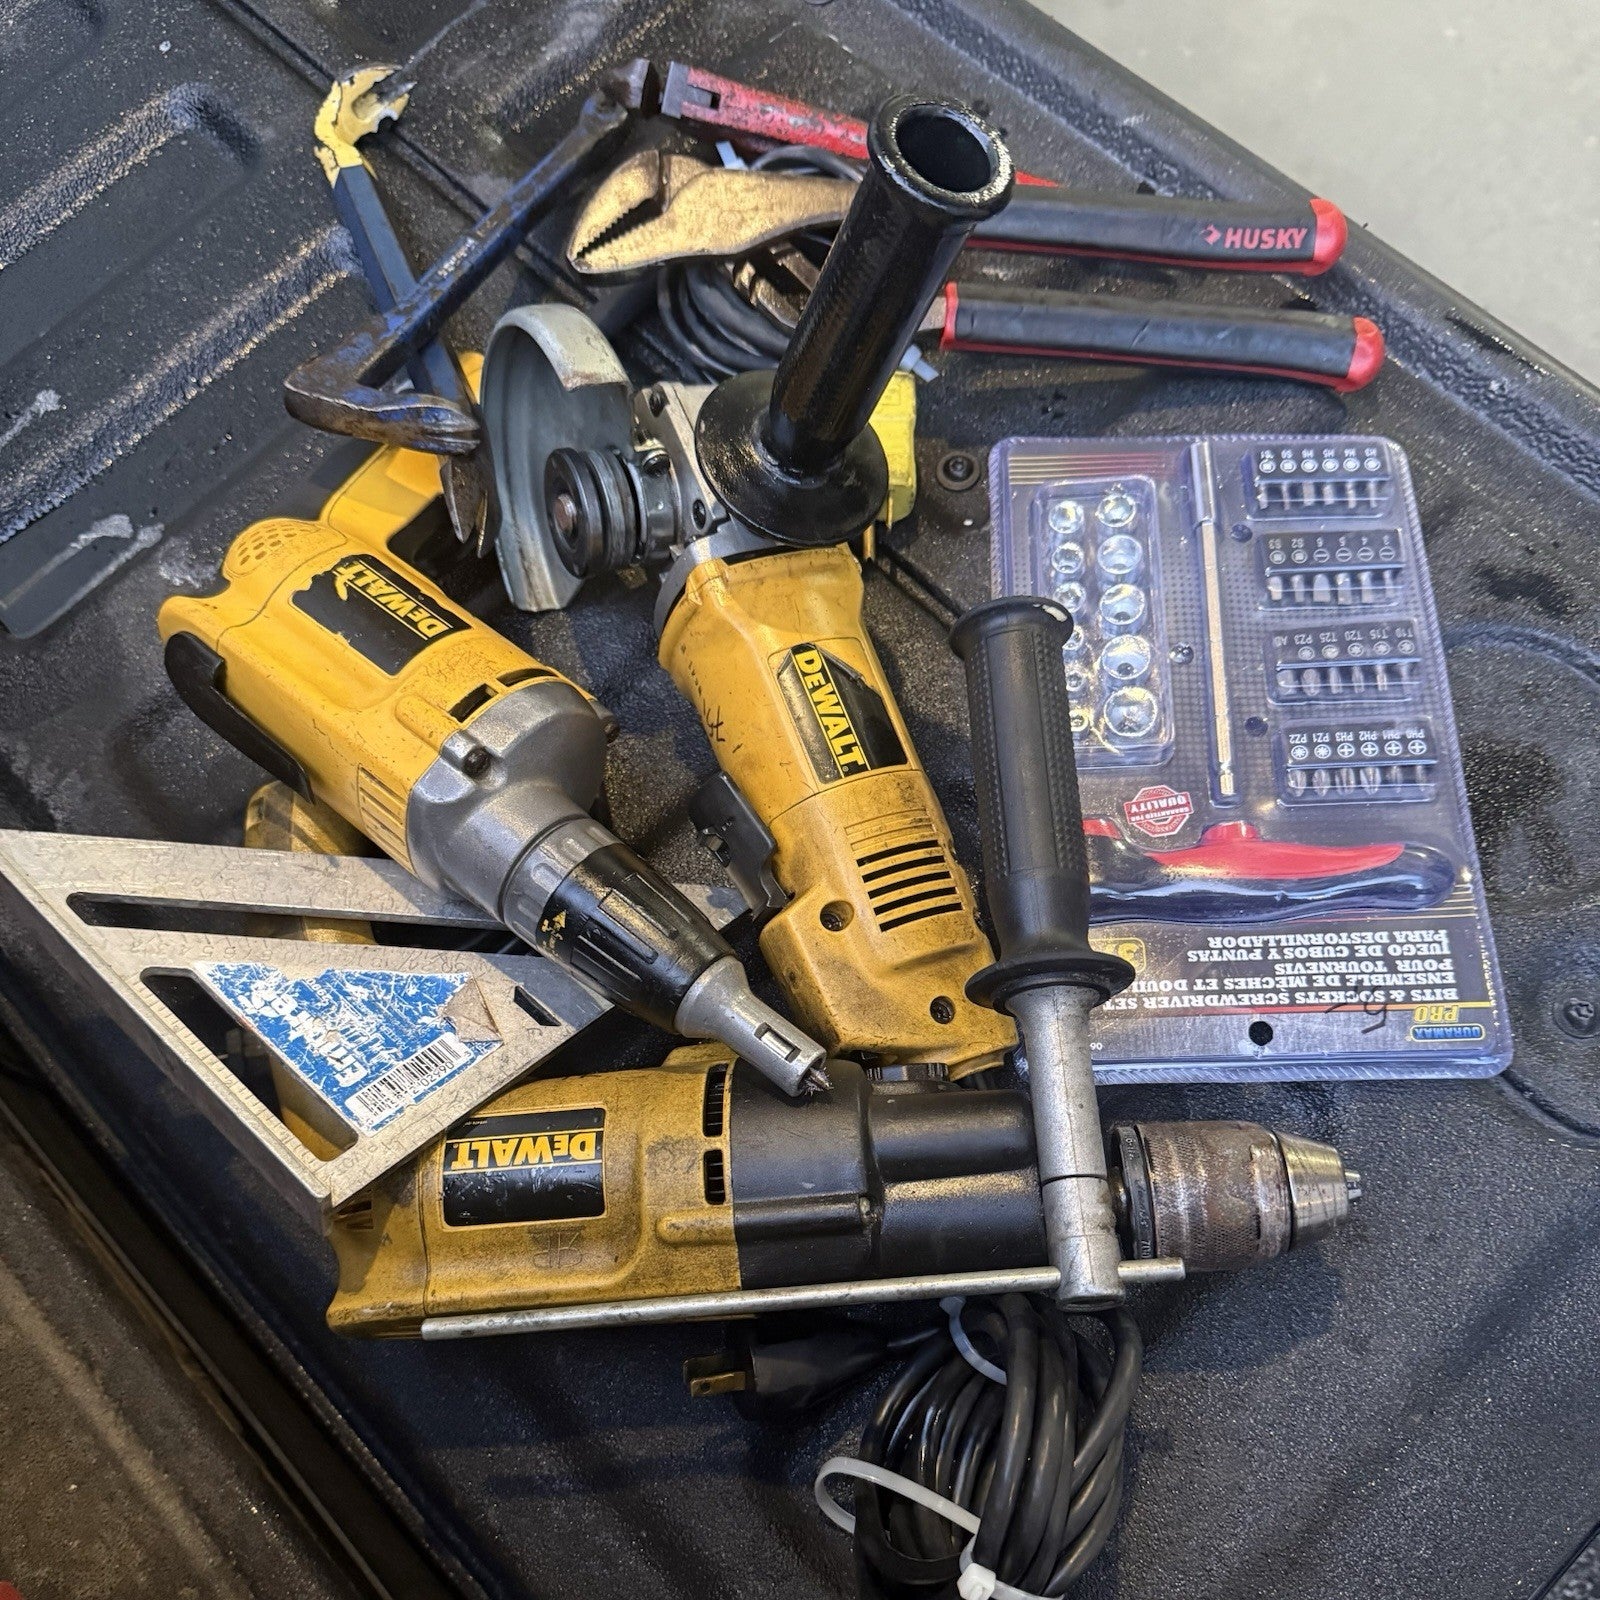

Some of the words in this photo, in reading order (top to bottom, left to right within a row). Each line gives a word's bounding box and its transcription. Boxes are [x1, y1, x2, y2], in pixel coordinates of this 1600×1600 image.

[1223, 227, 1308, 249] HUSKY
[1294, 634, 1313, 645] PZ3
[1319, 632, 1338, 642] T25
[1369, 629, 1388, 639] T15
[794, 649, 866, 768] DEWALT
[1288, 733, 1307, 744] PZ2
[1312, 732, 1330, 743] PZ1
[1335, 731, 1353, 742] PH3
[1359, 730, 1377, 741] PH2
[1130, 795, 1187, 813] QUALITY
[1207, 931, 1389, 948] DESTORNILLADOR
[1393, 929, 1449, 943] PARA
[1187, 949, 1263, 962] PUNTAS
[1267, 948, 1283, 960] Y
[1284, 946, 1347, 960] CUBOS
[1355, 945, 1384, 957] DE
[1388, 942, 1452, 956] JUEGO
[1275, 960, 1388, 975] TOURNEVIS
[1395, 959, 1454, 972] POUR
[1193, 978, 1219, 991] ET
[1224, 975, 1307, 992] MÈCHES
[1313, 974, 1340, 986] DE
[1346, 971, 1456, 986] ENSEMBLE
[1126, 979, 1188, 992] DOUIL
[1143, 991, 1290, 1008] SCREWDRIVER
[1293, 990, 1385, 1005] SOCKETS
[1390, 989, 1407, 1003] &
[1410, 988, 1459, 1001] BITS
[1413, 1005, 1460, 1022] PRO
[1414, 1027, 1481, 1039] DURAMAX
[451, 1131, 597, 1171] DEWALT
